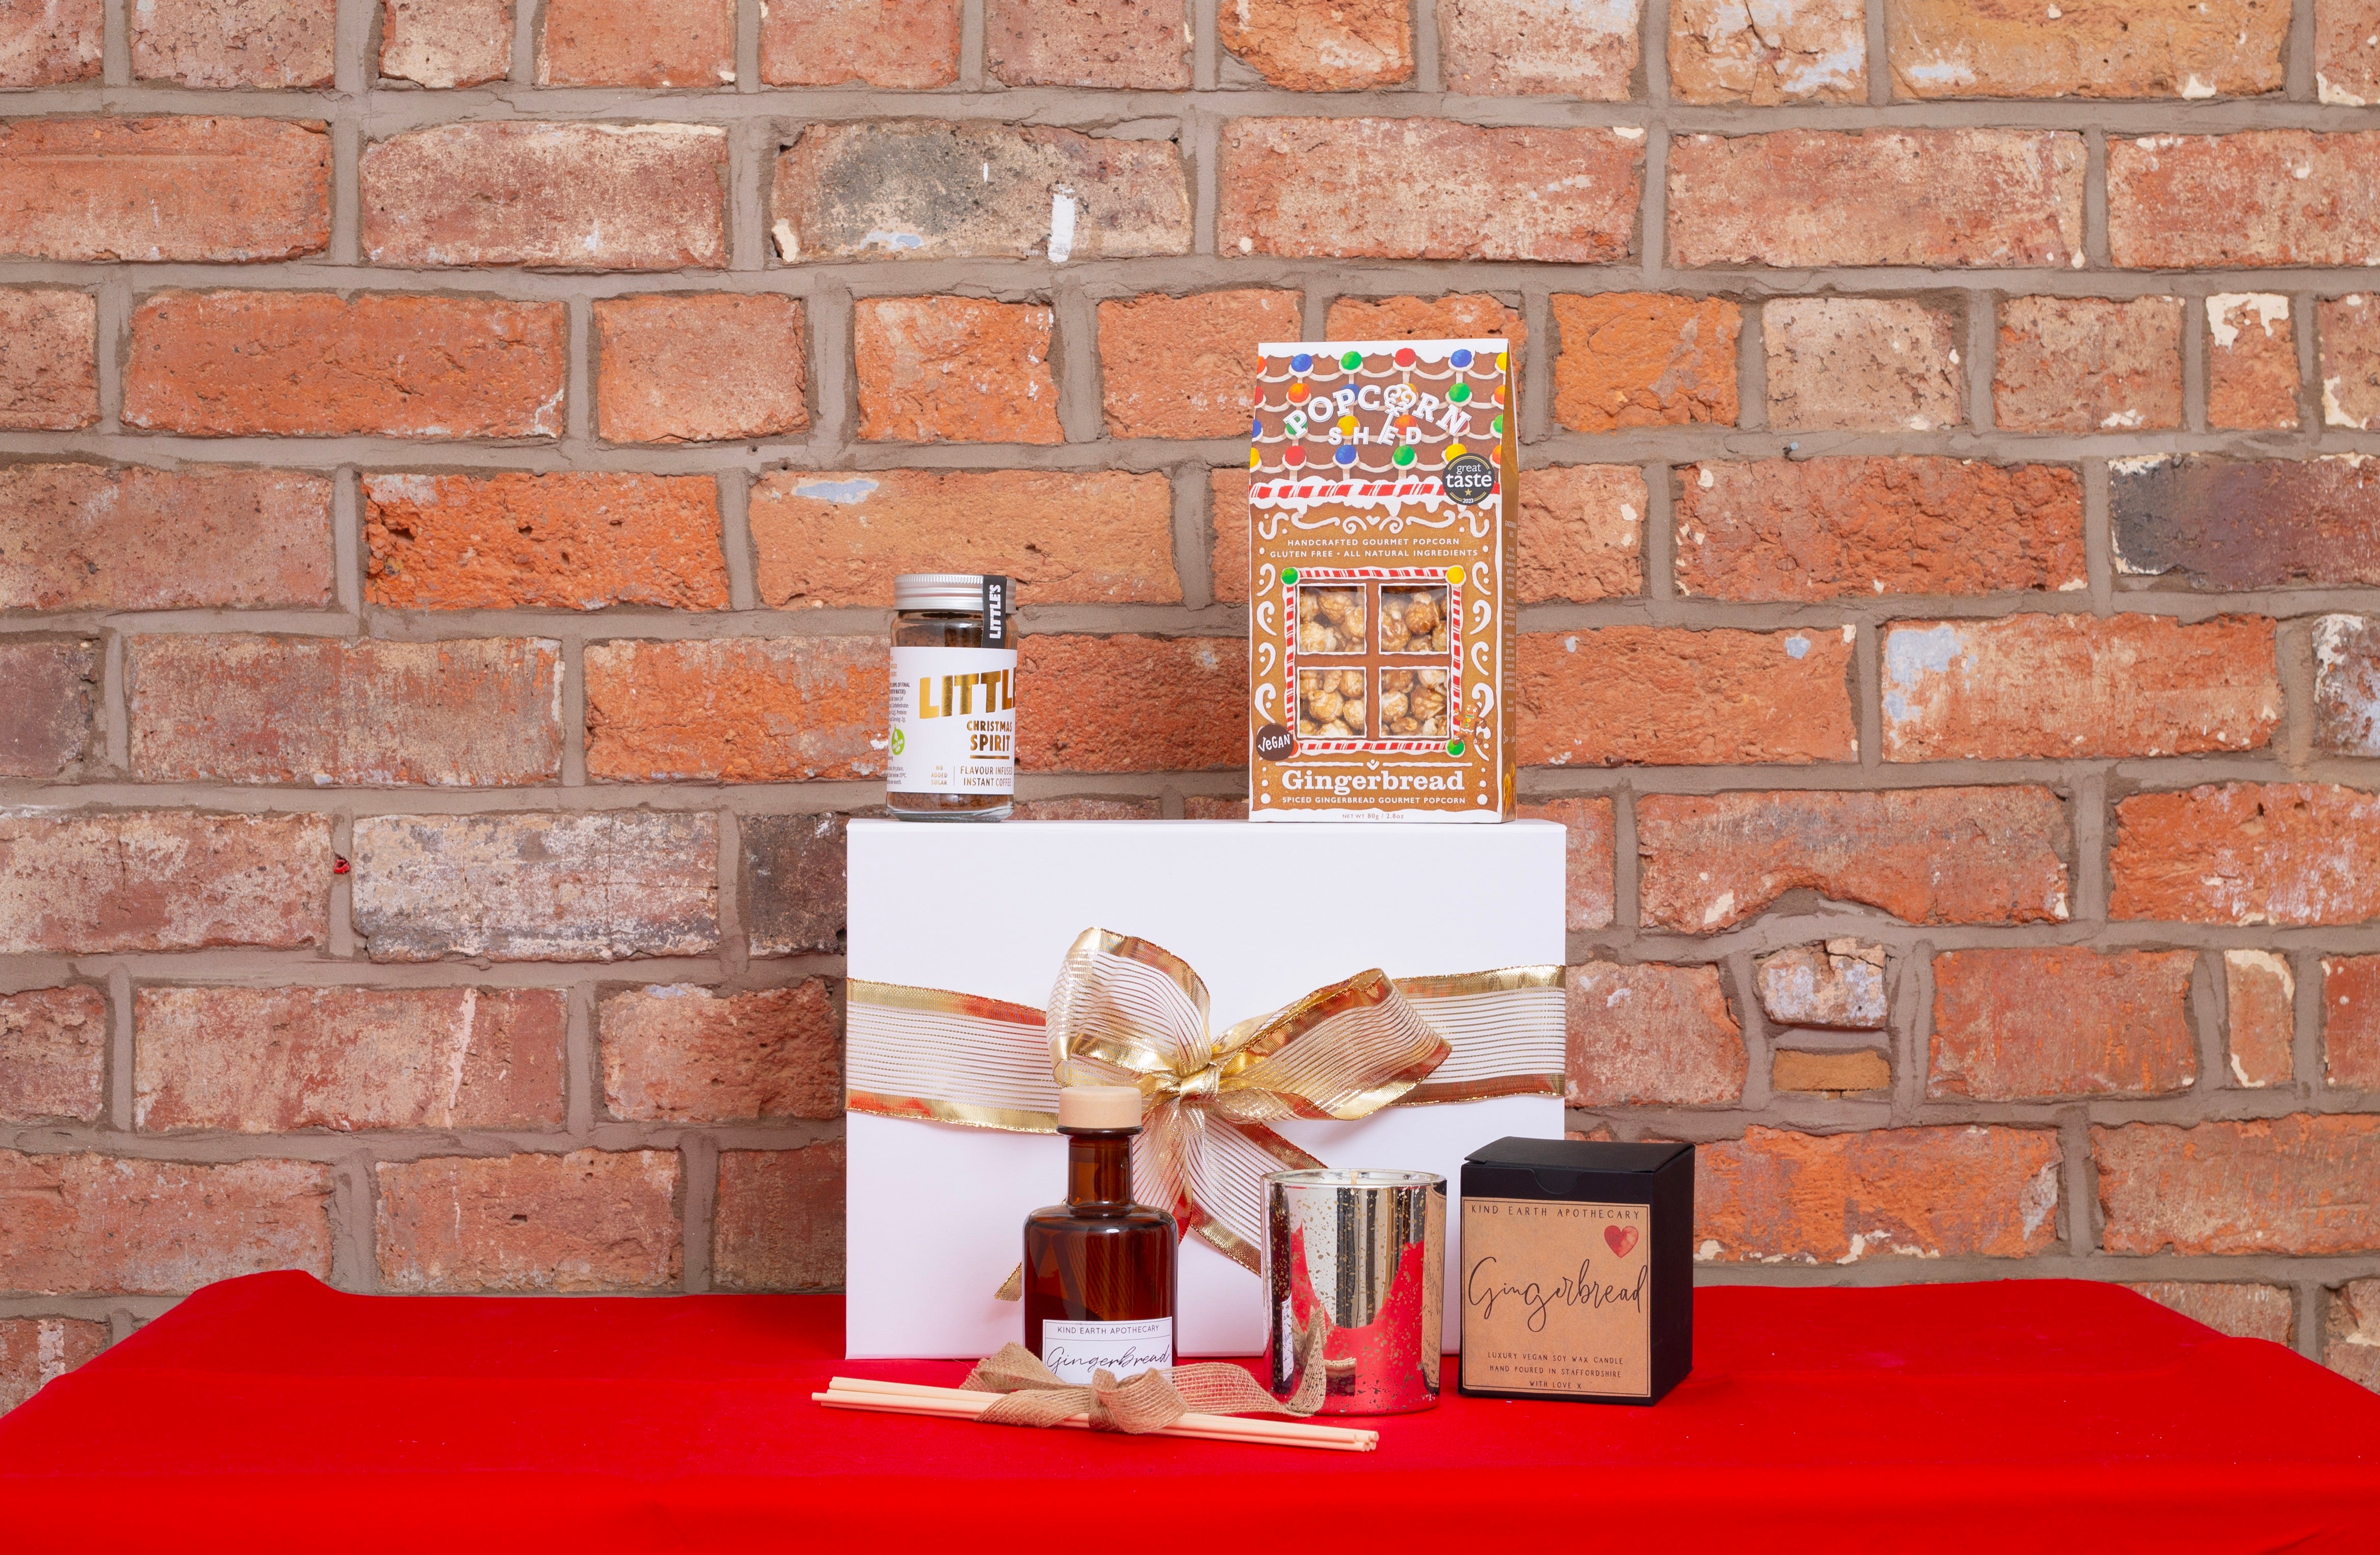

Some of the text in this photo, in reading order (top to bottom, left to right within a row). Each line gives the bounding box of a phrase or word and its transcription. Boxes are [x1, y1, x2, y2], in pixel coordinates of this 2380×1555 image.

[1283, 383, 1472, 439] POPCORN
[1328, 426, 1422, 446] SHED
[1456, 463, 1481, 475] great
[1445, 473, 1492, 487] taste
[1287, 538, 1358, 547] HANDCRAFTED
[1413, 549, 1478, 557] INGREDIENTS
[989, 584, 1001, 639] LITTLE'S
[967, 720, 1012, 732] CHRISTMAS
[970, 734, 1010, 751] SPIRIT
[961, 766, 1012, 775] FLAVOUR INFUSED
[964, 778, 1012, 787] INSTANT COFFEE
[1282, 770, 1465, 795] Gingerbread
[1471, 1205, 1640, 1220] KIND EARTH APOTHECARY
[1468, 1256, 1648, 1332] Gingerbread
[1110, 1325, 1159, 1334] APOTHECARY
[1488, 1352, 1517, 1360] LUXURY
[1594, 1357, 1623, 1365] CANDLE
[1561, 1368, 1621, 1378] STAFFORDSHIRE
